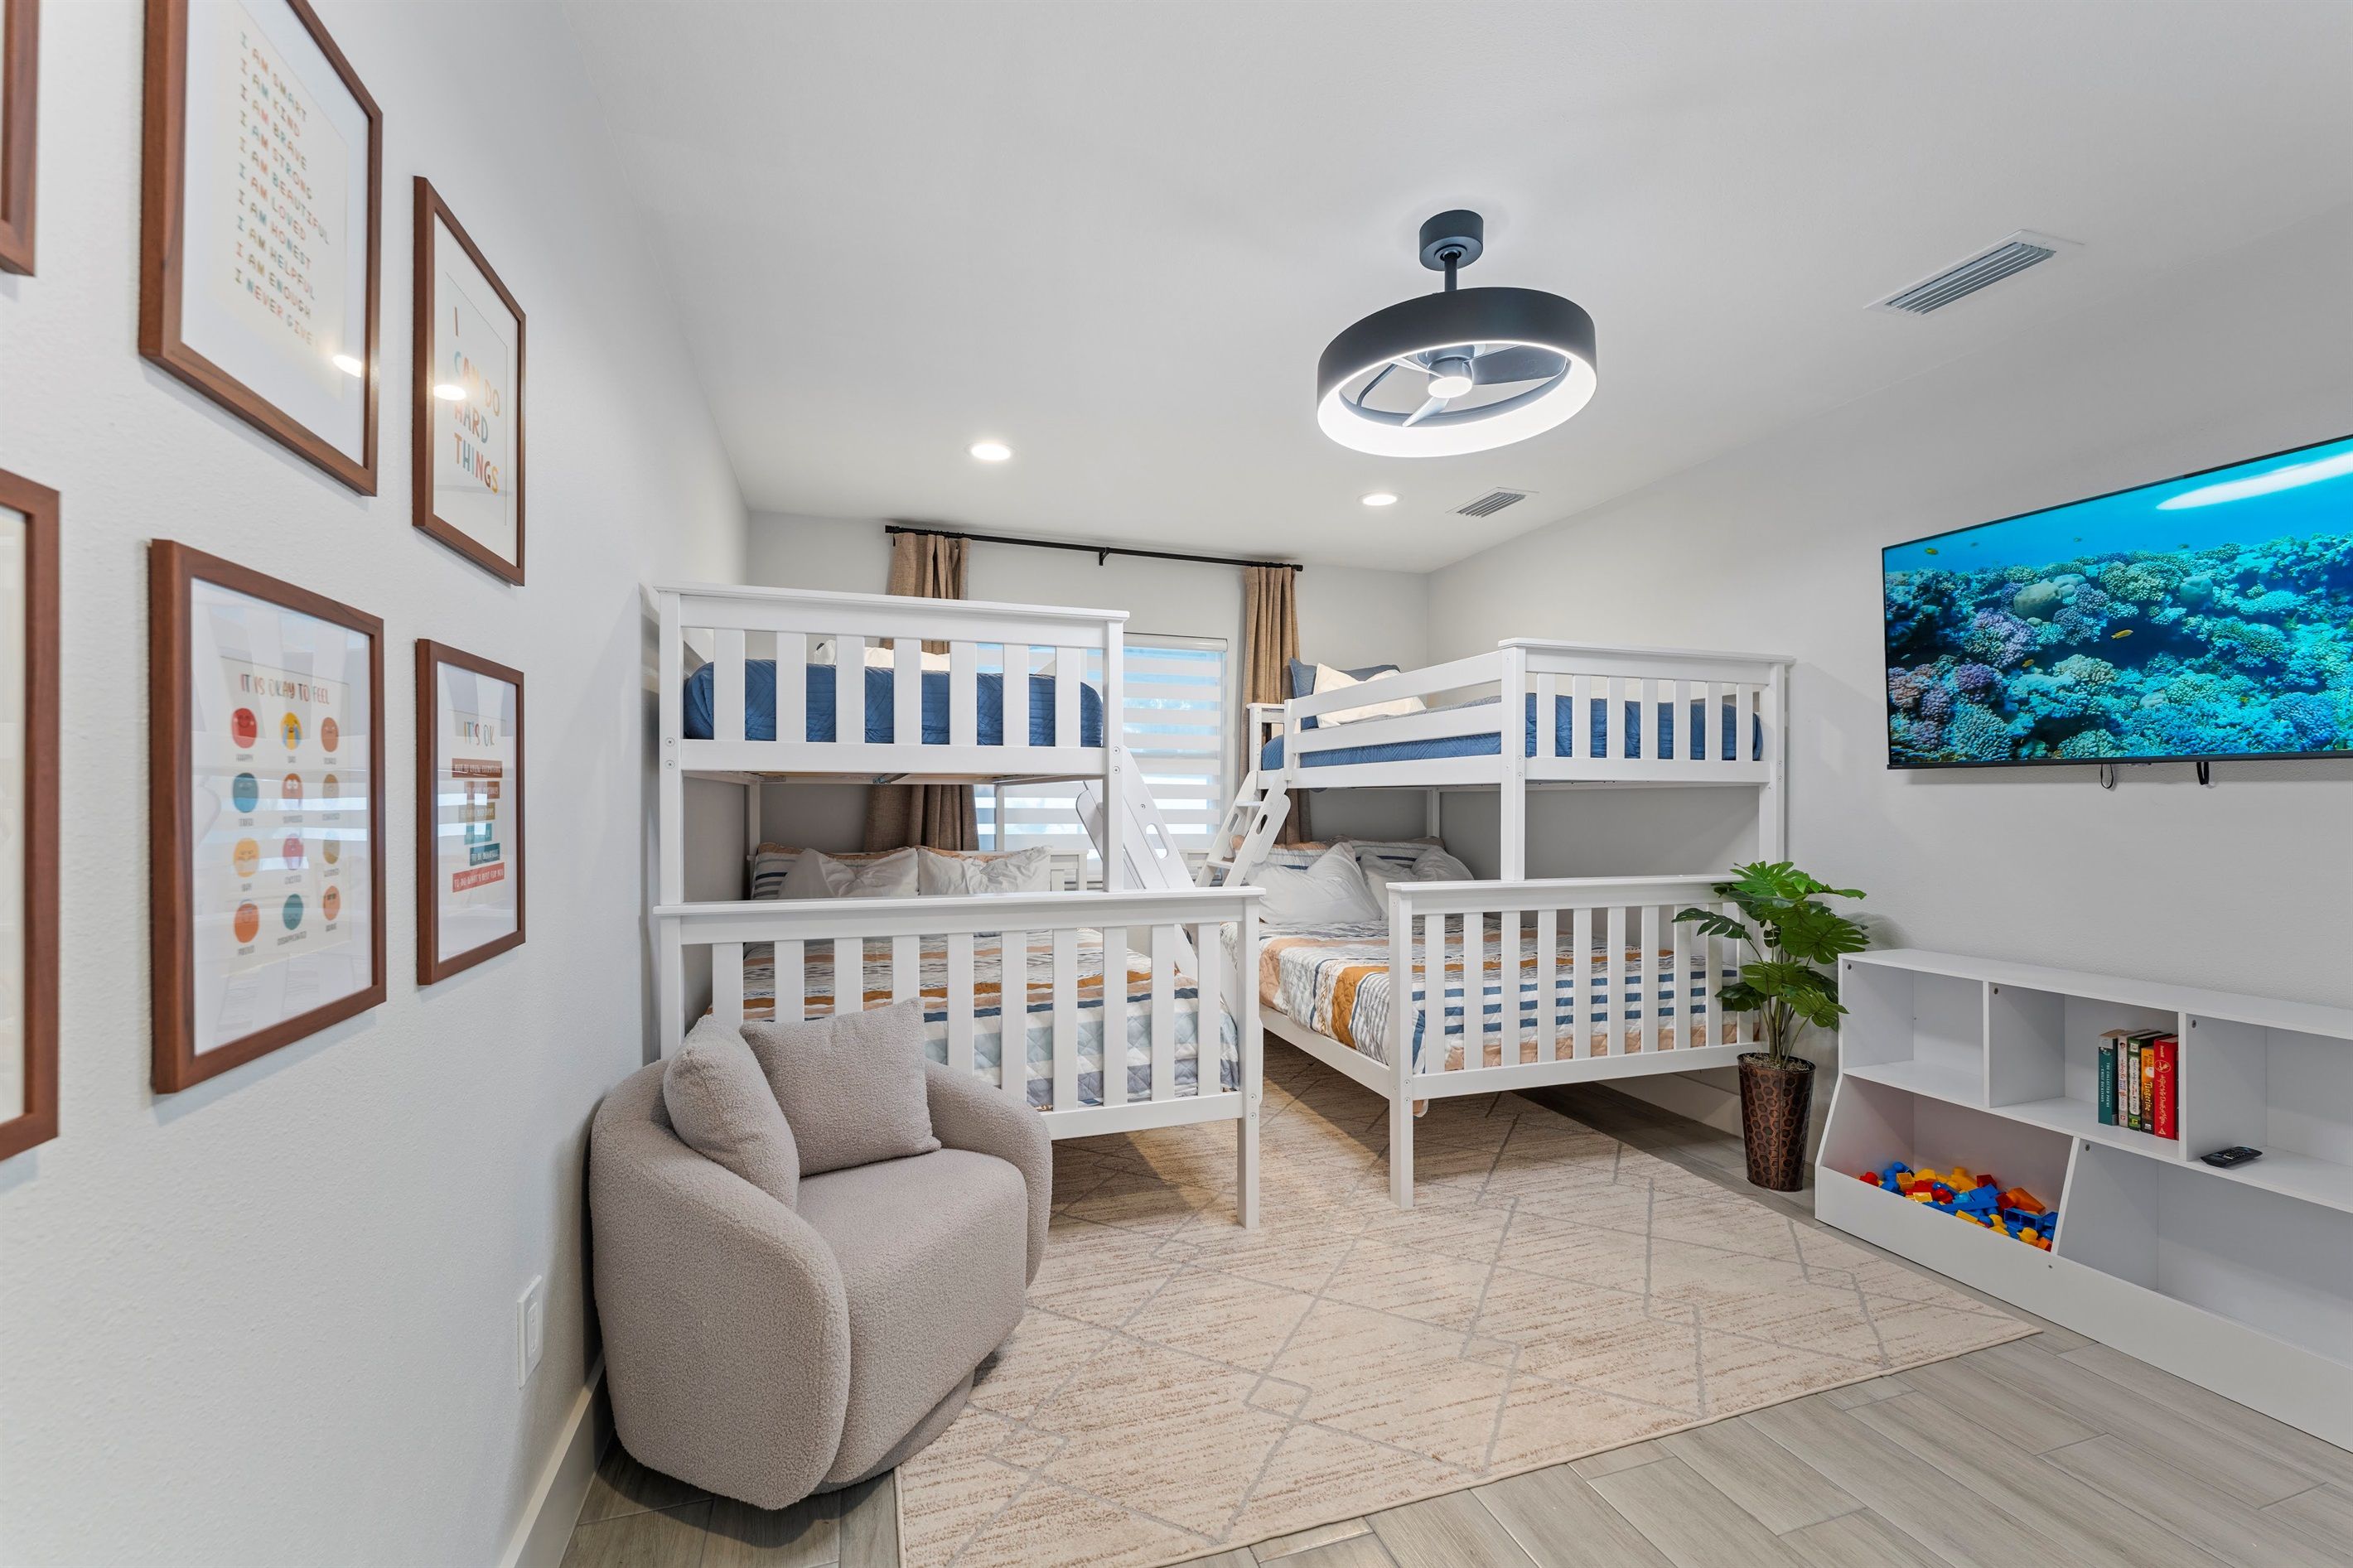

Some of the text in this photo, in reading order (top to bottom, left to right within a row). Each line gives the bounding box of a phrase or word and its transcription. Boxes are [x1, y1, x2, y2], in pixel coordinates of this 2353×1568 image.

[239, 56, 300, 138] I AM KIND
[240, 31, 307, 123] I AM SMART
[239, 83, 307, 171] I AM BRAVE
[239, 111, 312, 200] I AM STRONG
[238, 162, 307, 241] I AM LOVED
[238, 188, 312, 270] I AM HONEST
[239, 137, 330, 245] I AM BEAUTIFUL
[236, 241, 312, 321] I AM ENOUGH
[237, 215, 315, 301] I AM HELPFUL
[234, 268, 312, 346] I NEVER GIVE
[454, 306, 458, 337] I
[454, 401, 488, 444] HARD
[483, 379, 500, 417] DO
[454, 432, 499, 494] THINGS
[240, 673, 330, 705] IT IS OKAY TO FEEL
[484, 724, 495, 746] OK
[2144, 1082, 2152, 1112] Tangerine
